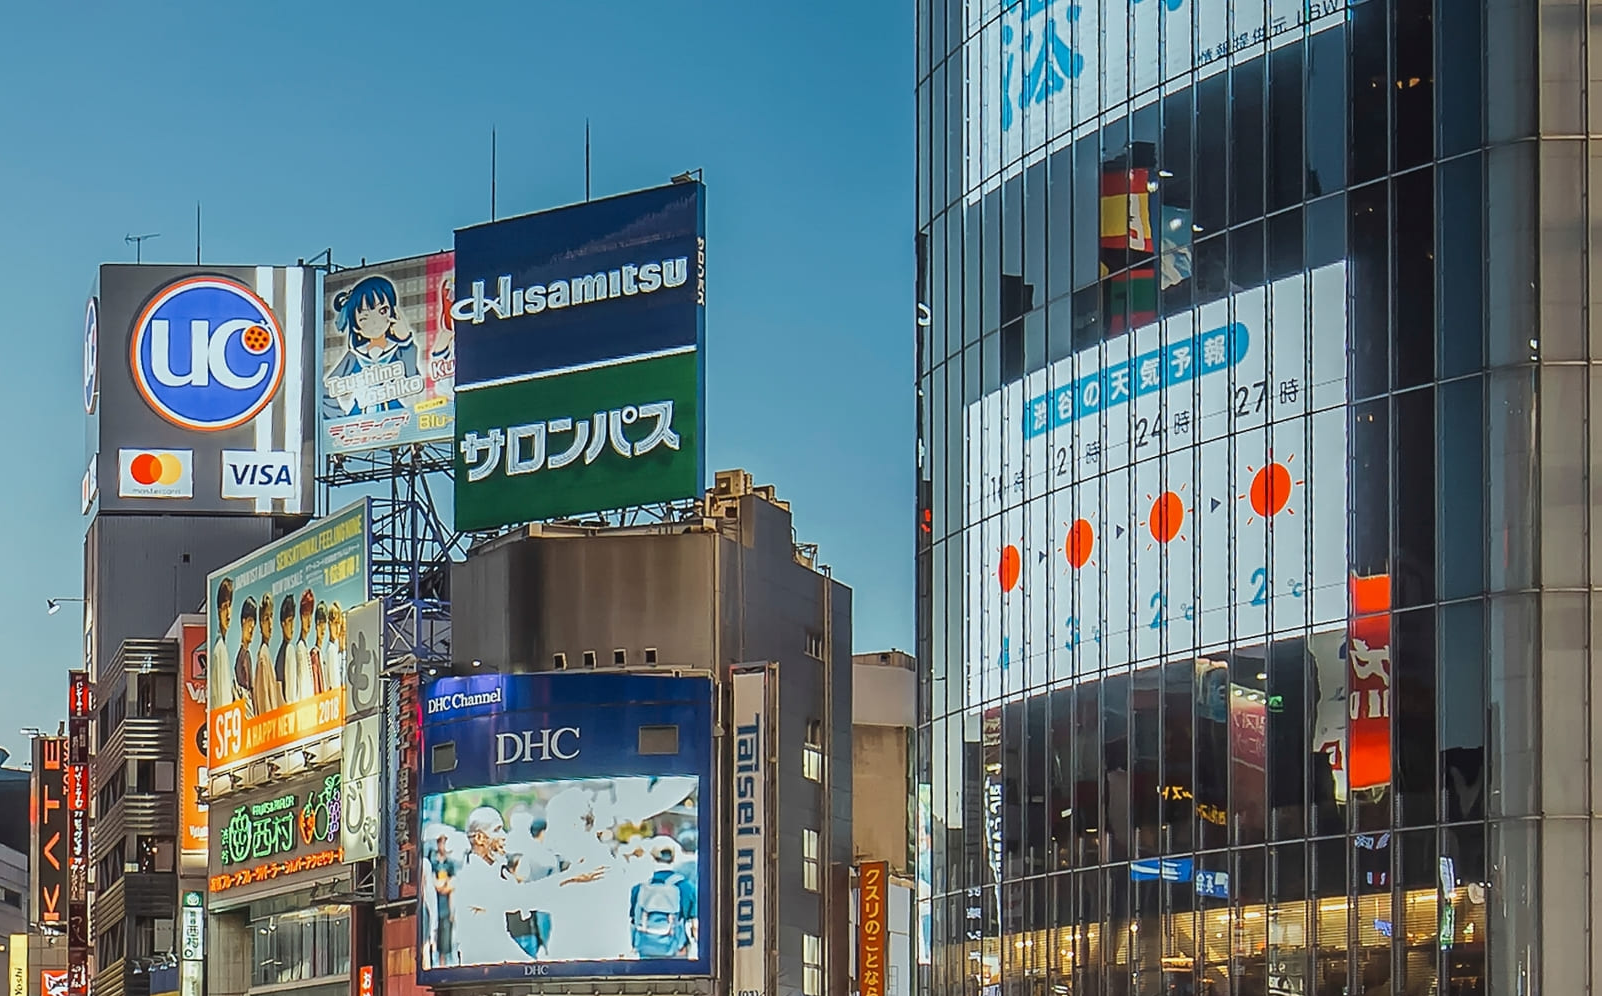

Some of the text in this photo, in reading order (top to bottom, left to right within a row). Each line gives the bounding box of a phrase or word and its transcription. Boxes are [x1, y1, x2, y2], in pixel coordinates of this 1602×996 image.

[450, 256, 688, 325] Hisamitsu
[329, 362, 403, 396] Tsushima
[1033, 334, 1226, 431] 渋谷の天気予報
[460, 400, 680, 483] サロンパス
[229, 463, 292, 487] VISA
[246, 728, 252, 749] A
[252, 719, 278, 746] HAPPY
[277, 712, 296, 737] NEW
[318, 696, 340, 724] 2018
[427, 687, 502, 714] DHC Channel
[215, 707, 241, 760] SF9
[344, 631, 380, 854] もんじゃ
[495, 726, 581, 766] DHC
[252, 811, 294, 858] 西村
[737, 712, 760, 949] Taisei neon
[524, 965, 549, 976] DHC
